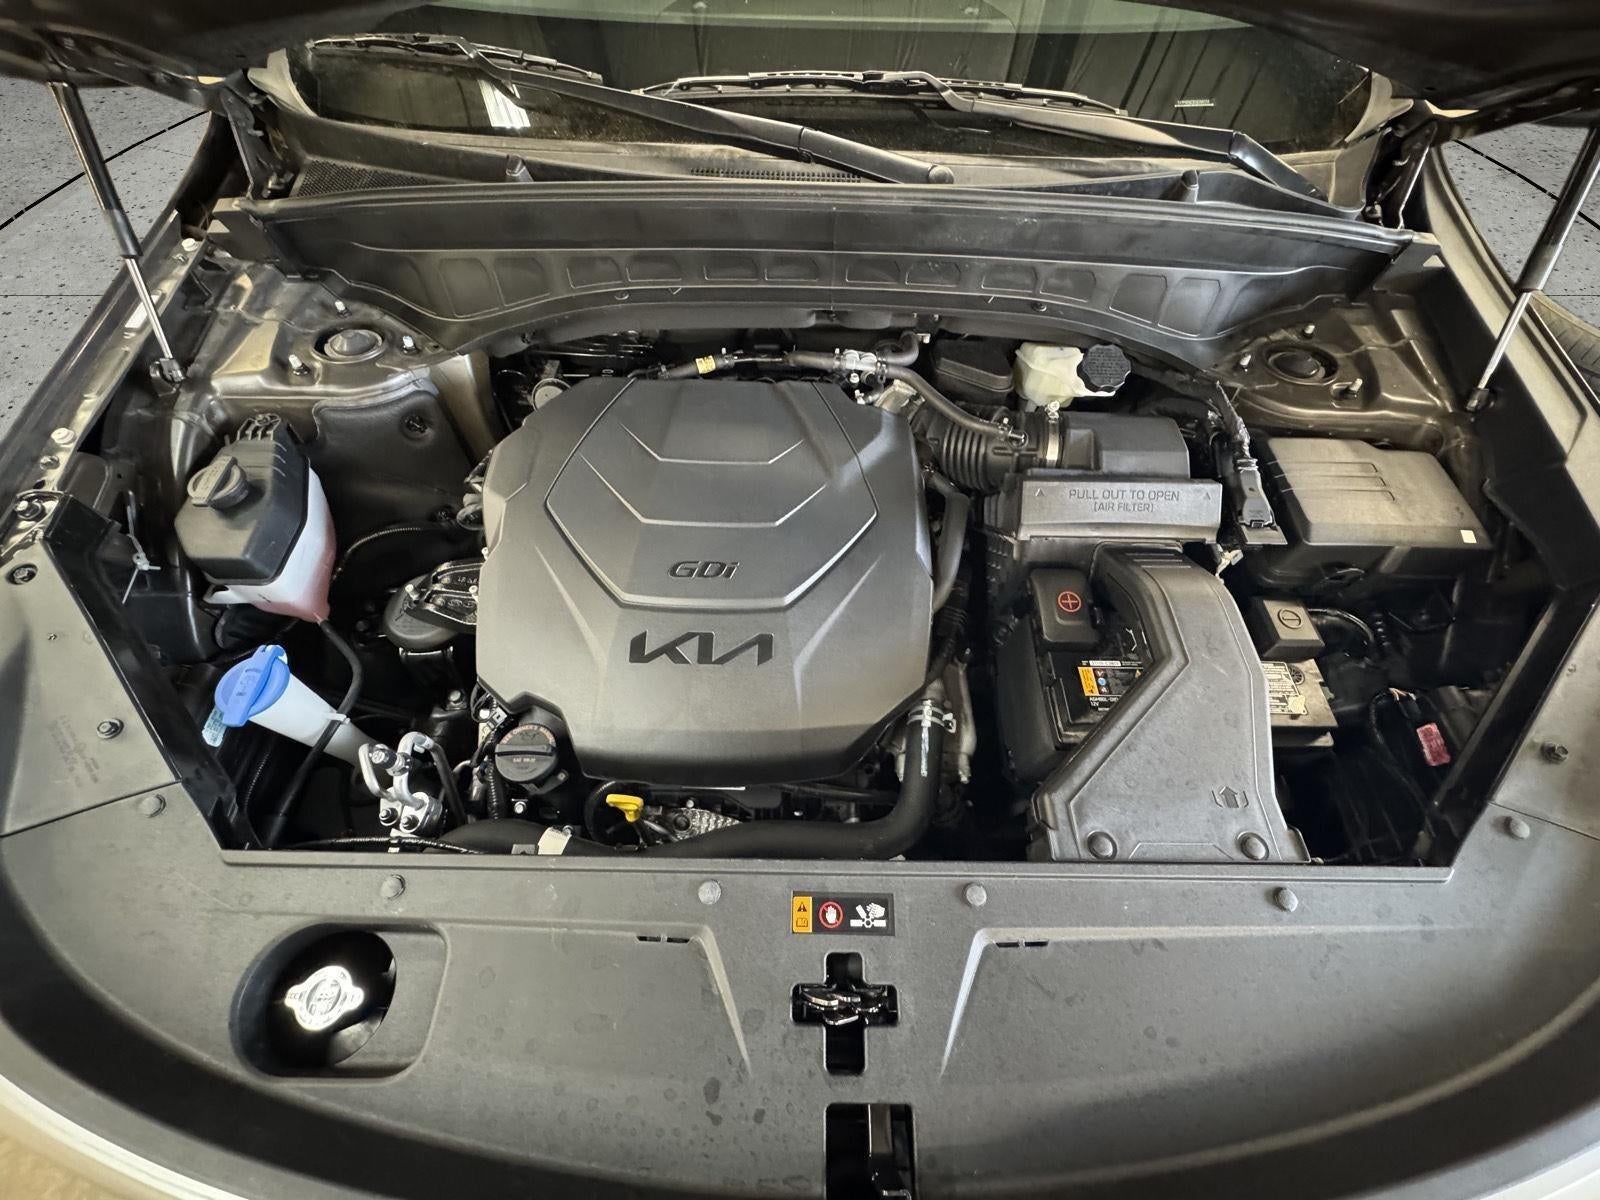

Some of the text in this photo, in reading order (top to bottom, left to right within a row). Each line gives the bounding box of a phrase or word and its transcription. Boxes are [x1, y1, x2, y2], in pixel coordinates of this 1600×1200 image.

[1069, 488, 1180, 502] PULL OUT TO OPEN
[667, 560, 740, 580] GDi
[629, 629, 775, 667] KIA
